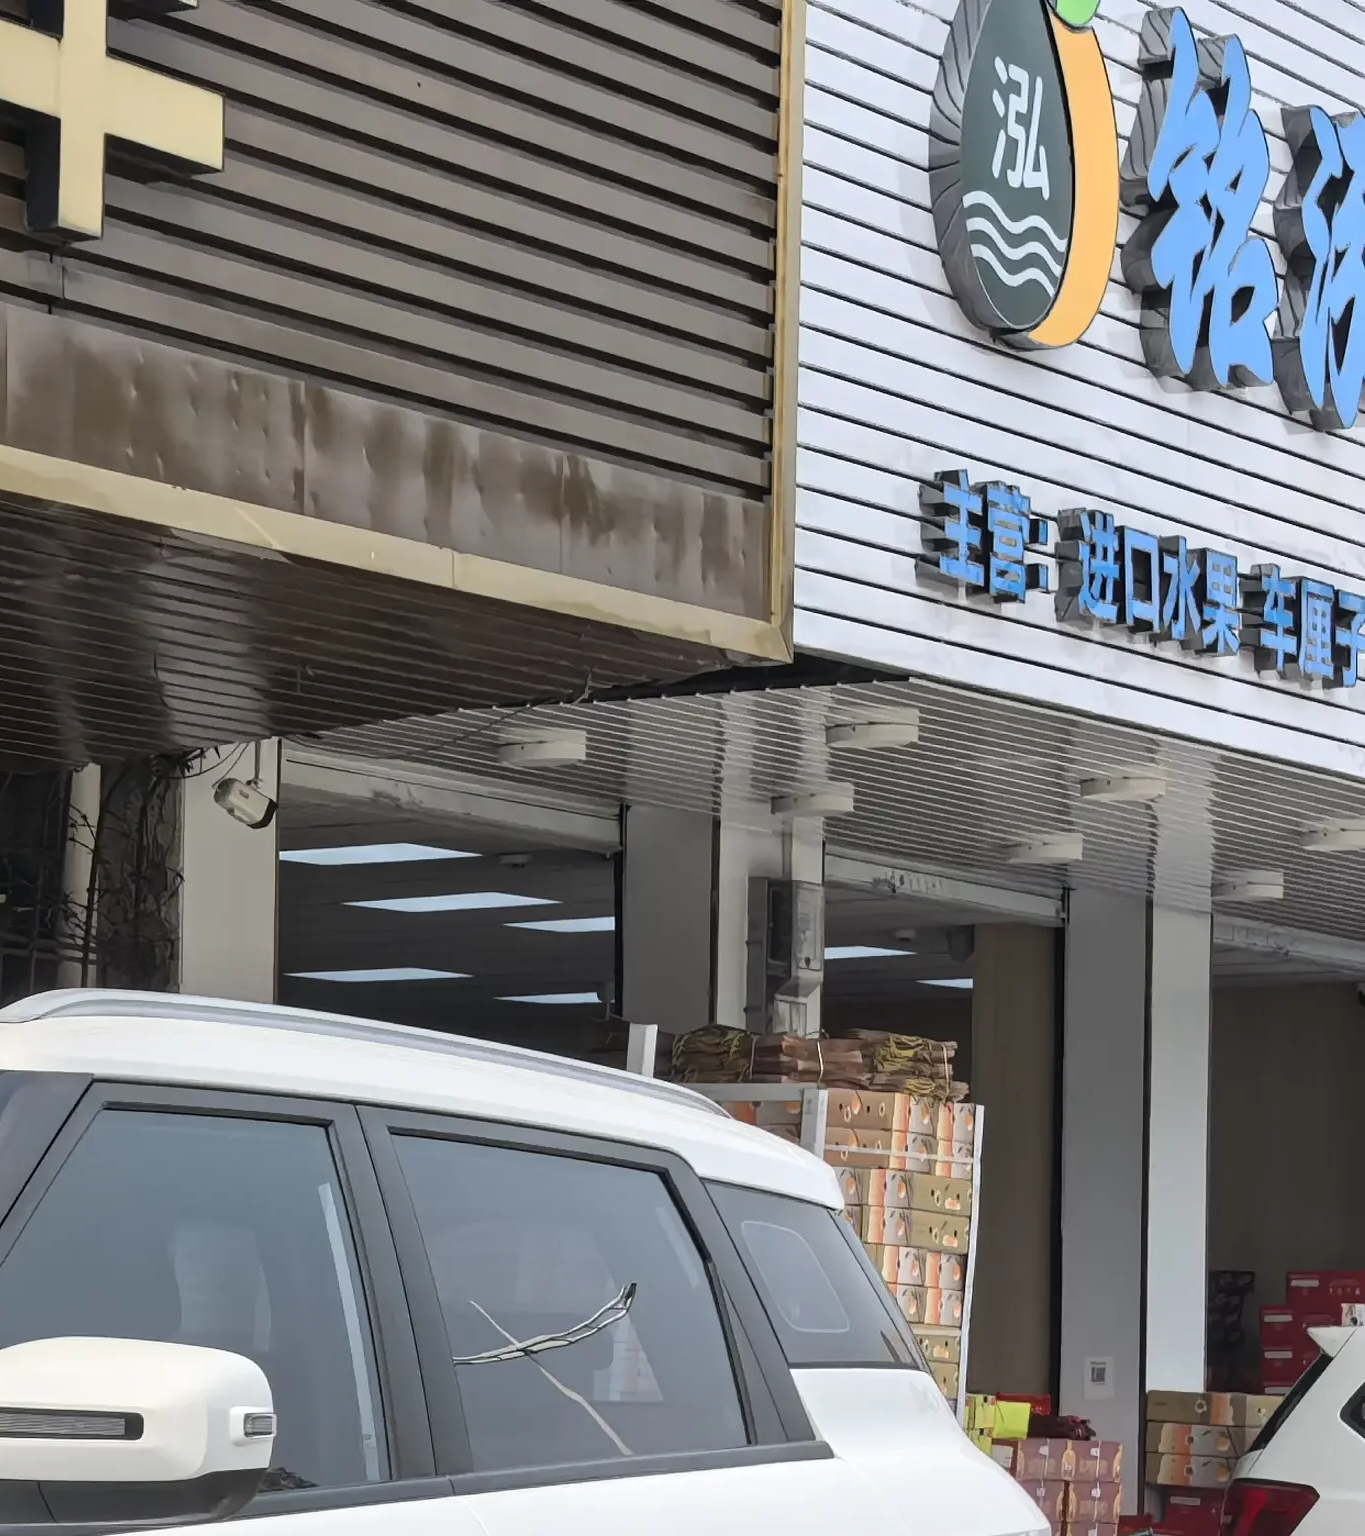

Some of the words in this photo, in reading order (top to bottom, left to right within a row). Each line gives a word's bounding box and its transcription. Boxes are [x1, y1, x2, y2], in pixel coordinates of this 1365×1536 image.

[991, 55, 1051, 201] 泓
[1077, 508, 1241, 657] 进口水果
